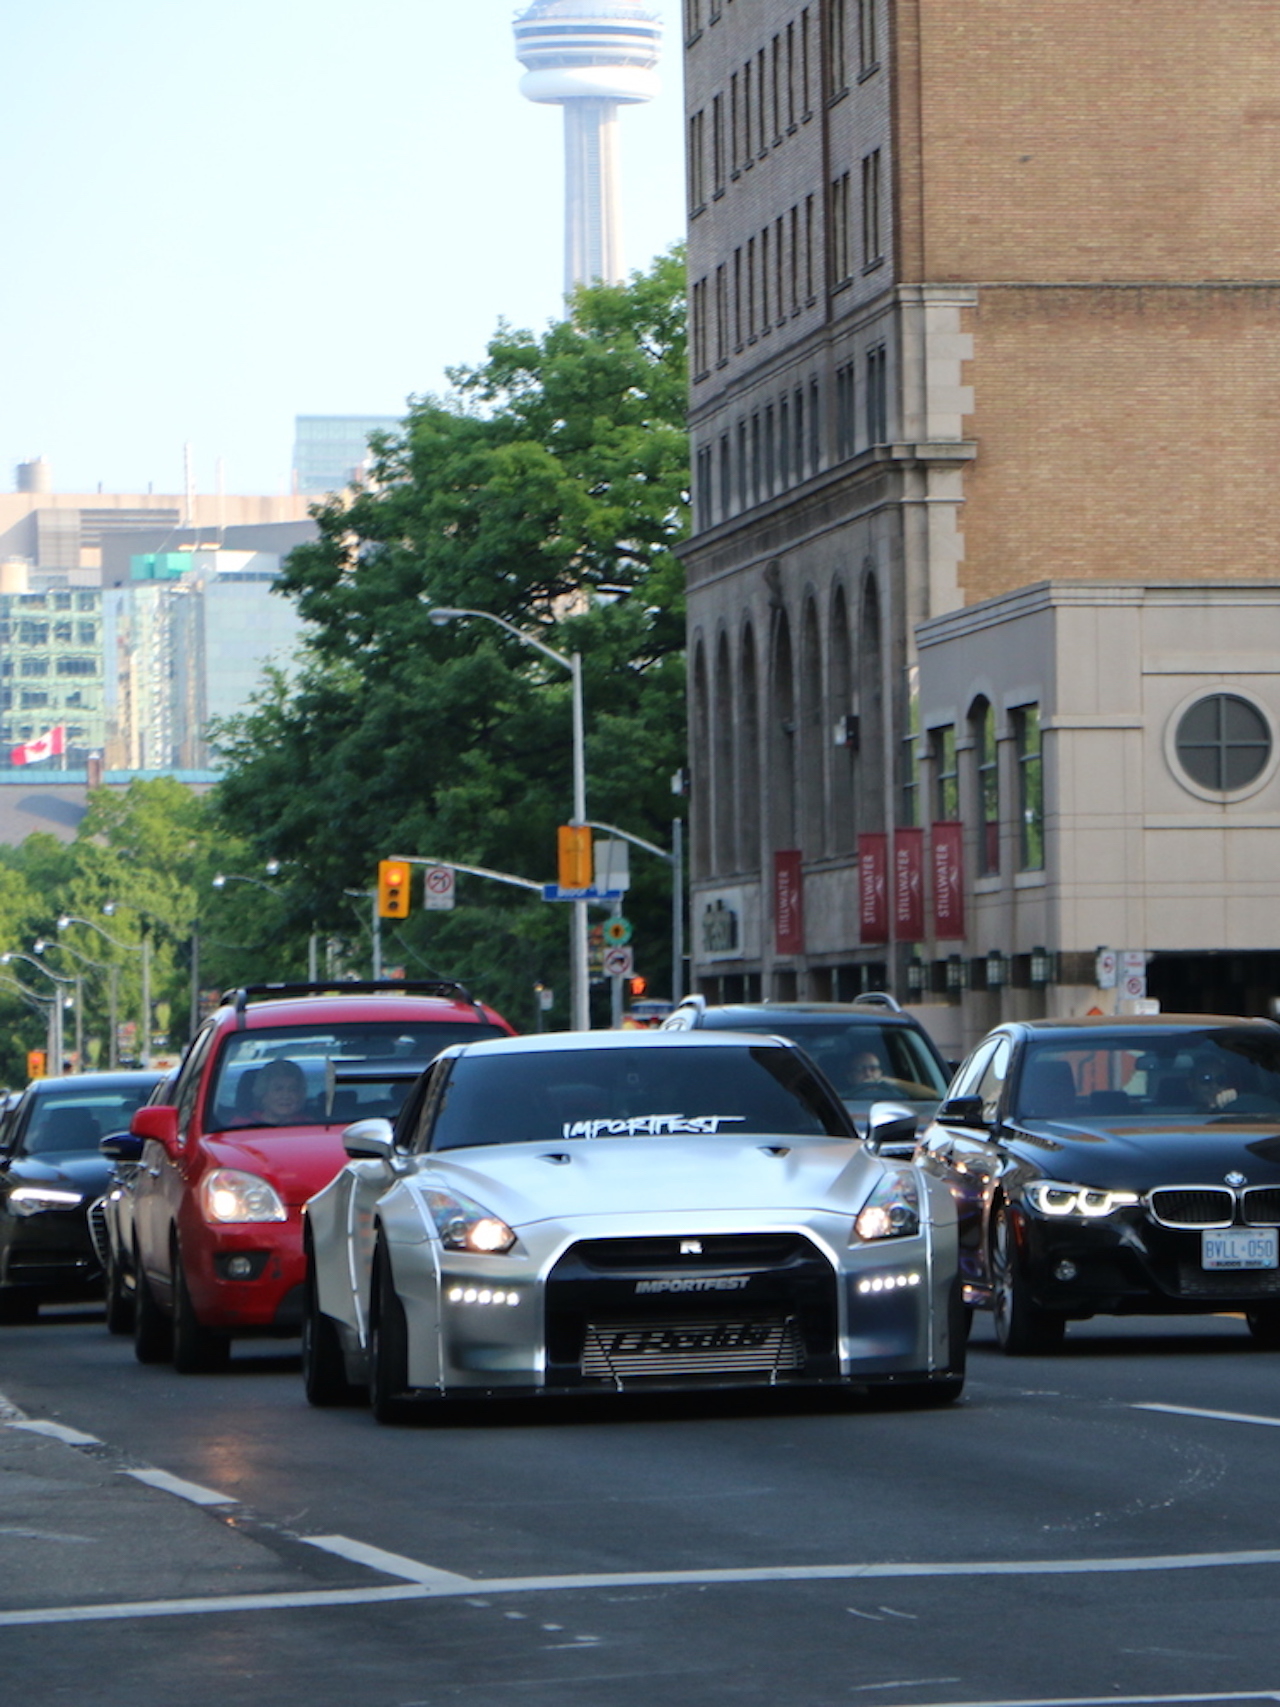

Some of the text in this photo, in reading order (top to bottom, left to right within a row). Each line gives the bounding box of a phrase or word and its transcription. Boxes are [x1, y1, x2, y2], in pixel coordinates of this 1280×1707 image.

[778, 870, 789, 935] STILLWATER
[863, 854, 875, 924] STILLWATER
[898, 849, 910, 921] STILLWATER
[936, 843, 950, 918] STILLWATER
[563, 1114, 746, 1139] IMPORTFEST
[1206, 1241, 1239, 1258] BVLL
[635, 1276, 750, 1294] IMPORTFEST
